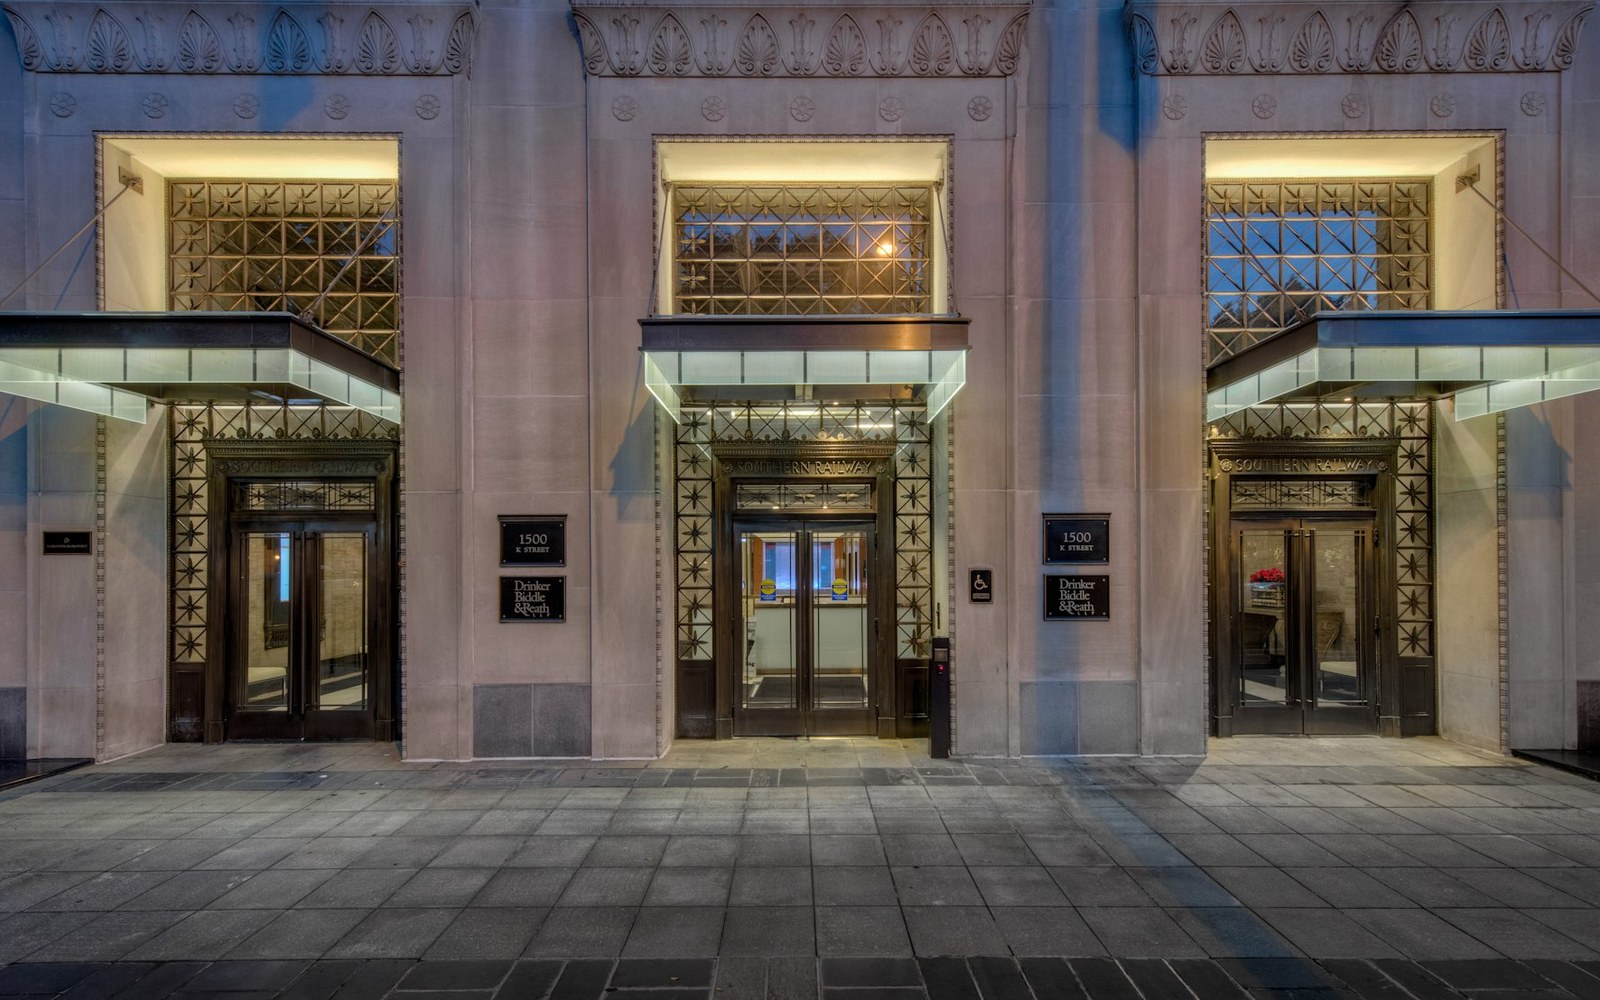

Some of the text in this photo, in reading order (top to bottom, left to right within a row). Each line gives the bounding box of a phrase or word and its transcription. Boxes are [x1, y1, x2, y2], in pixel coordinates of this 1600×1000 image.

[737, 461, 872, 474] SOUTHERN RAILWAY
[1235, 459, 1373, 471] SOUTHERN RAILWAY
[519, 534, 547, 545] 1500
[1063, 532, 1091, 543] 1500
[514, 580, 551, 591] Drinker
[1059, 579, 1095, 589] Drinker
[514, 592, 546, 602] Biddle
[1059, 590, 1090, 600] Biddle
